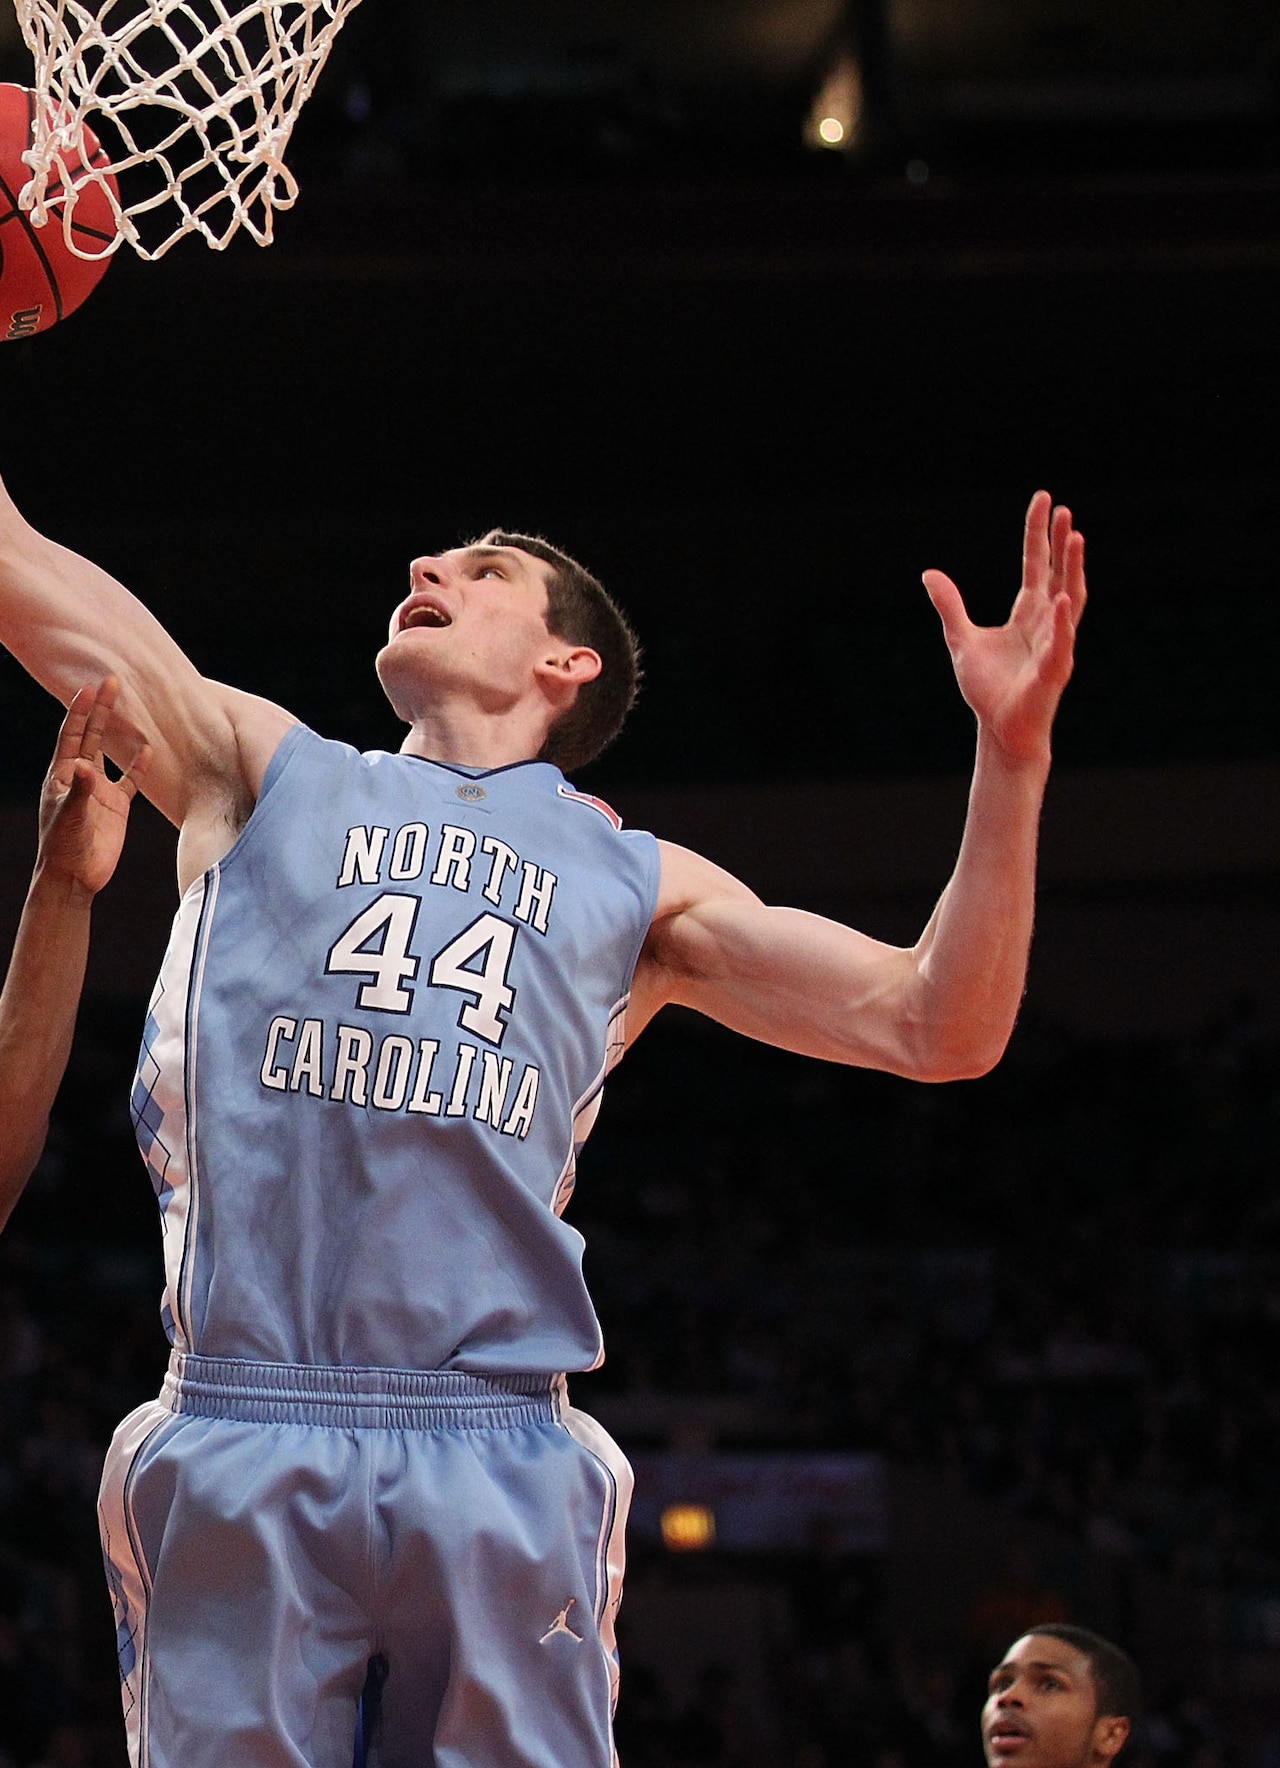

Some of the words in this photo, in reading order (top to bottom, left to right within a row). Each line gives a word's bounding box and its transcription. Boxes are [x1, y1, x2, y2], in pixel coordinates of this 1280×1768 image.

[336, 822, 558, 936] NORTH
[324, 892, 519, 1048] 44
[260, 1016, 540, 1141] CAROLINA
